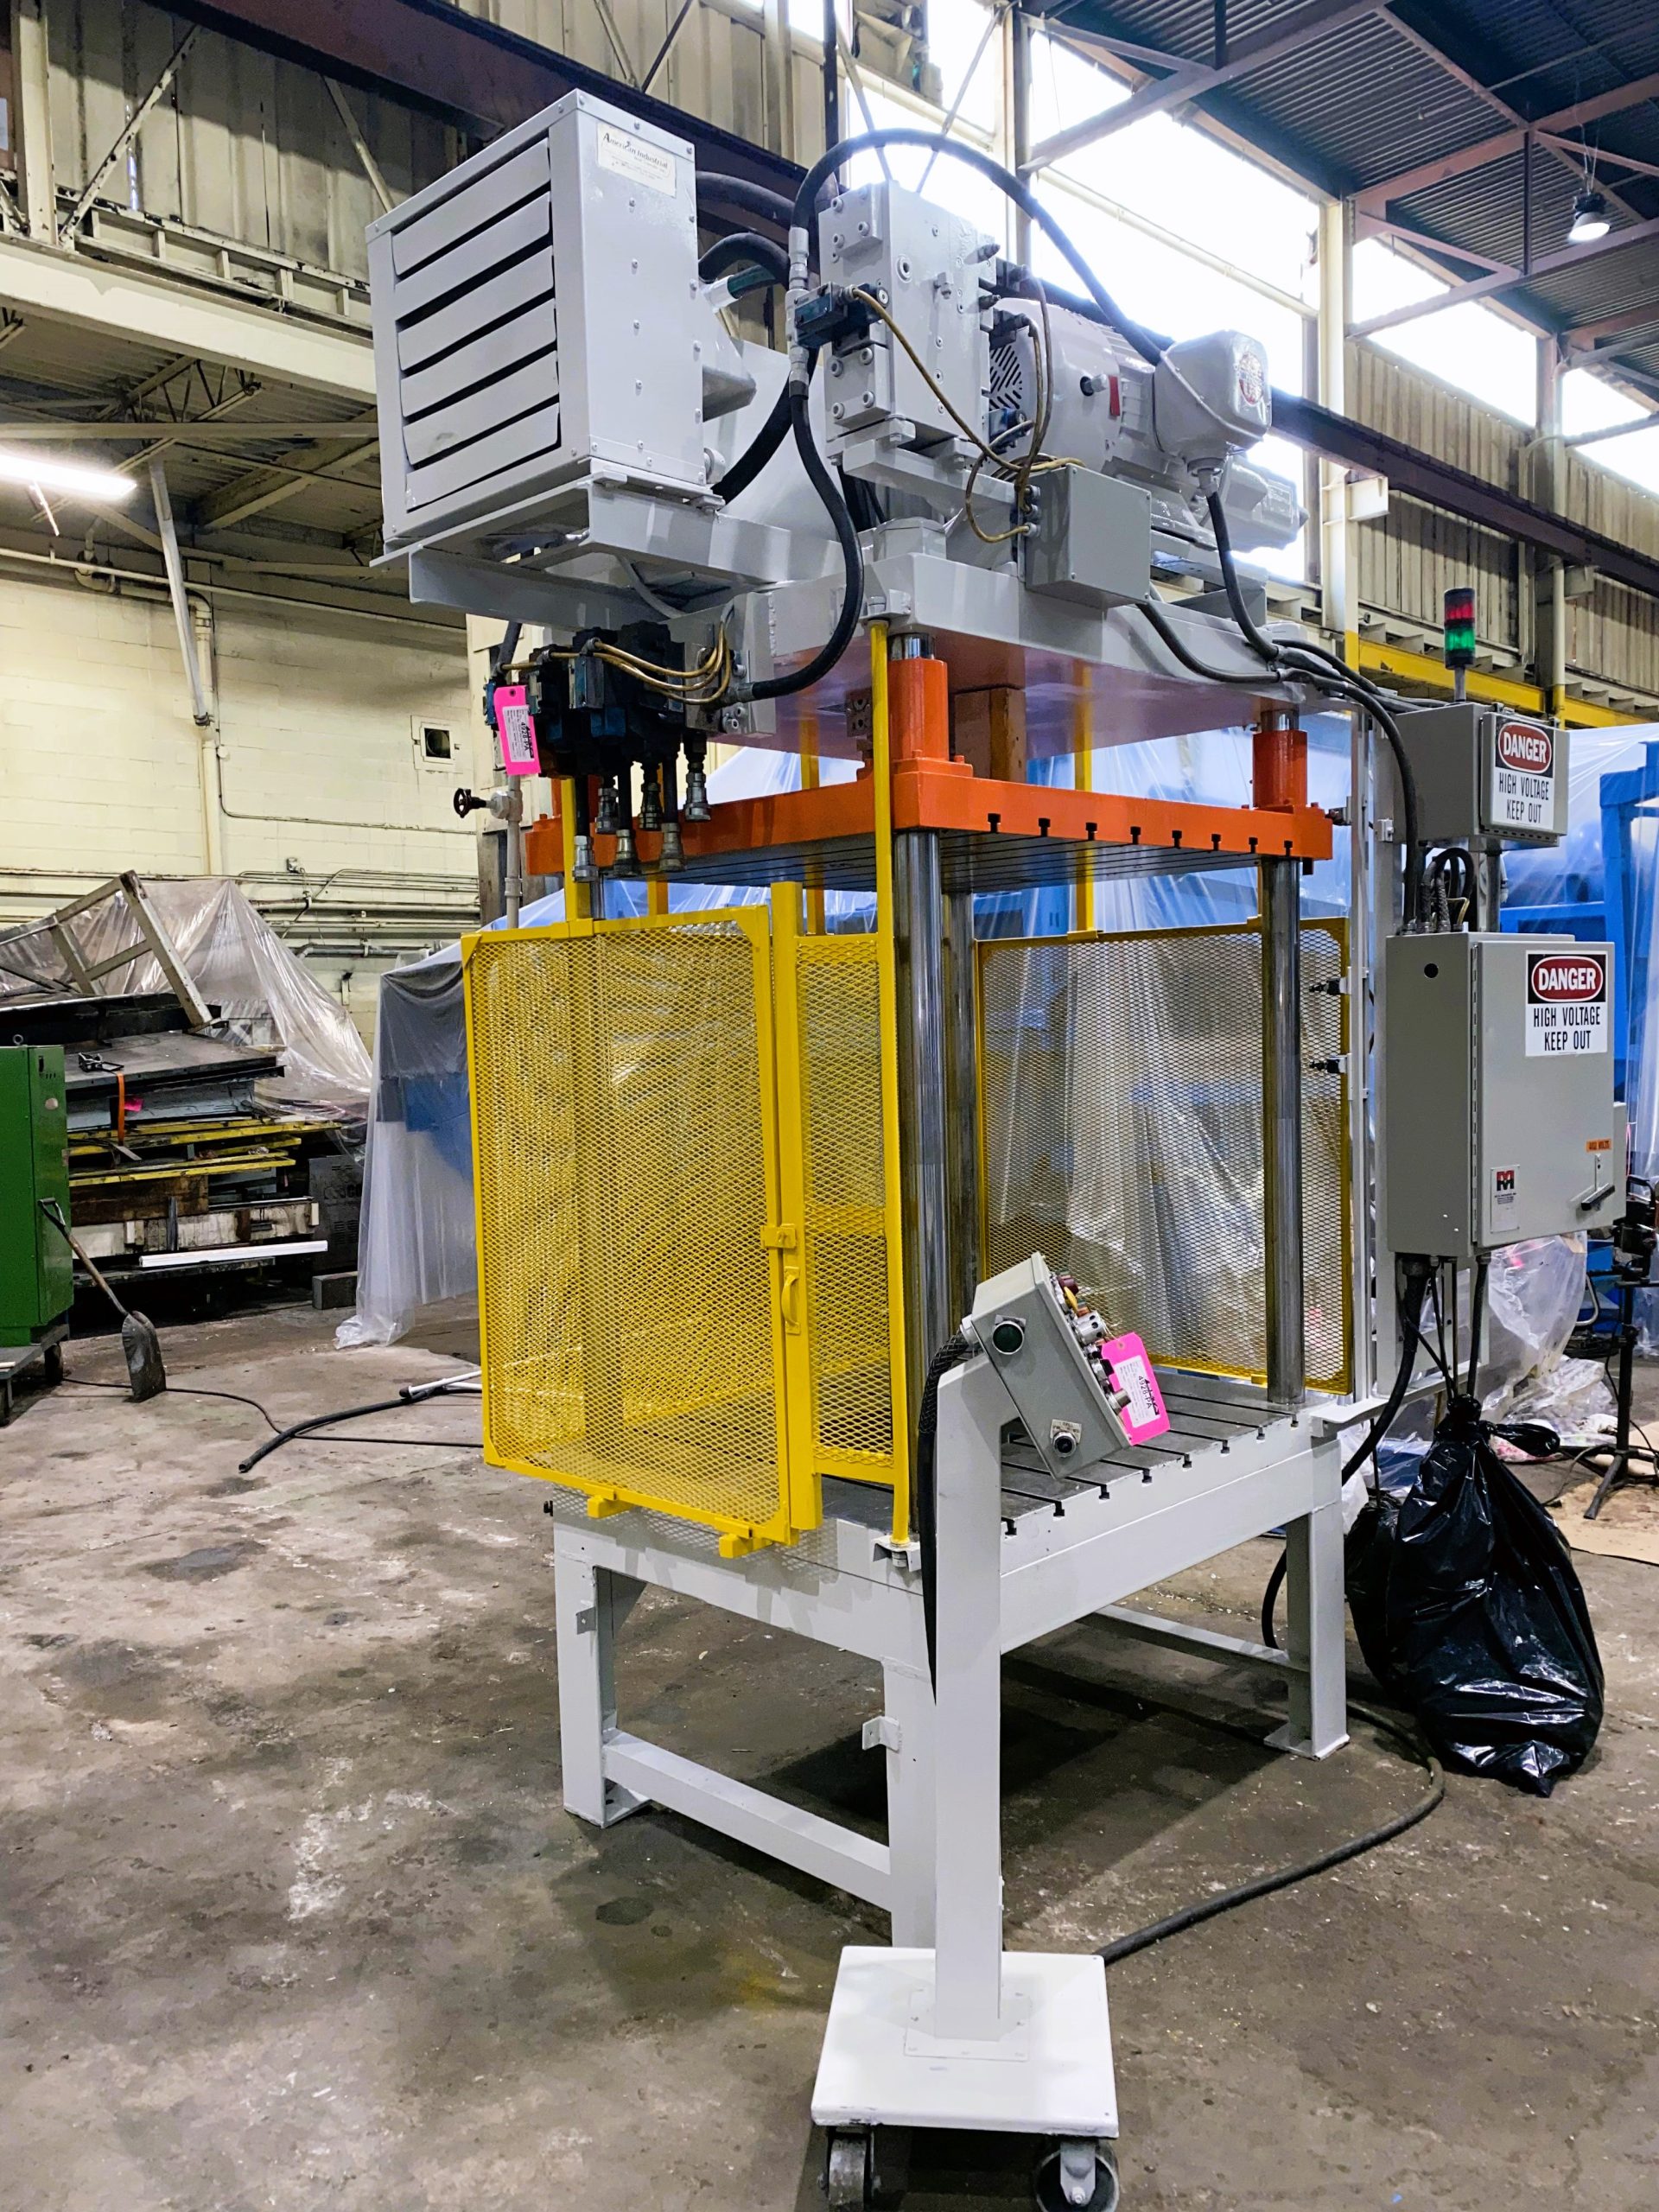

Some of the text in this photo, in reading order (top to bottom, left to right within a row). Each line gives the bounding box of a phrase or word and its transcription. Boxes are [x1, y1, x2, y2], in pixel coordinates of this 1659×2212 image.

[638, 149, 668, 169] Industrial
[1503, 731, 1547, 763] DANGER
[1499, 772, 1549, 800] HIGH VOLTAGE
[1507, 799, 1541, 823] KEEP OUT
[1538, 968, 1596, 991] DANGER
[1534, 1007, 1600, 1027] HIGH VOLTAGE
[1545, 1031, 1591, 1051] KEEP OUT
[1138, 1376, 1152, 1409] 4928-PA
